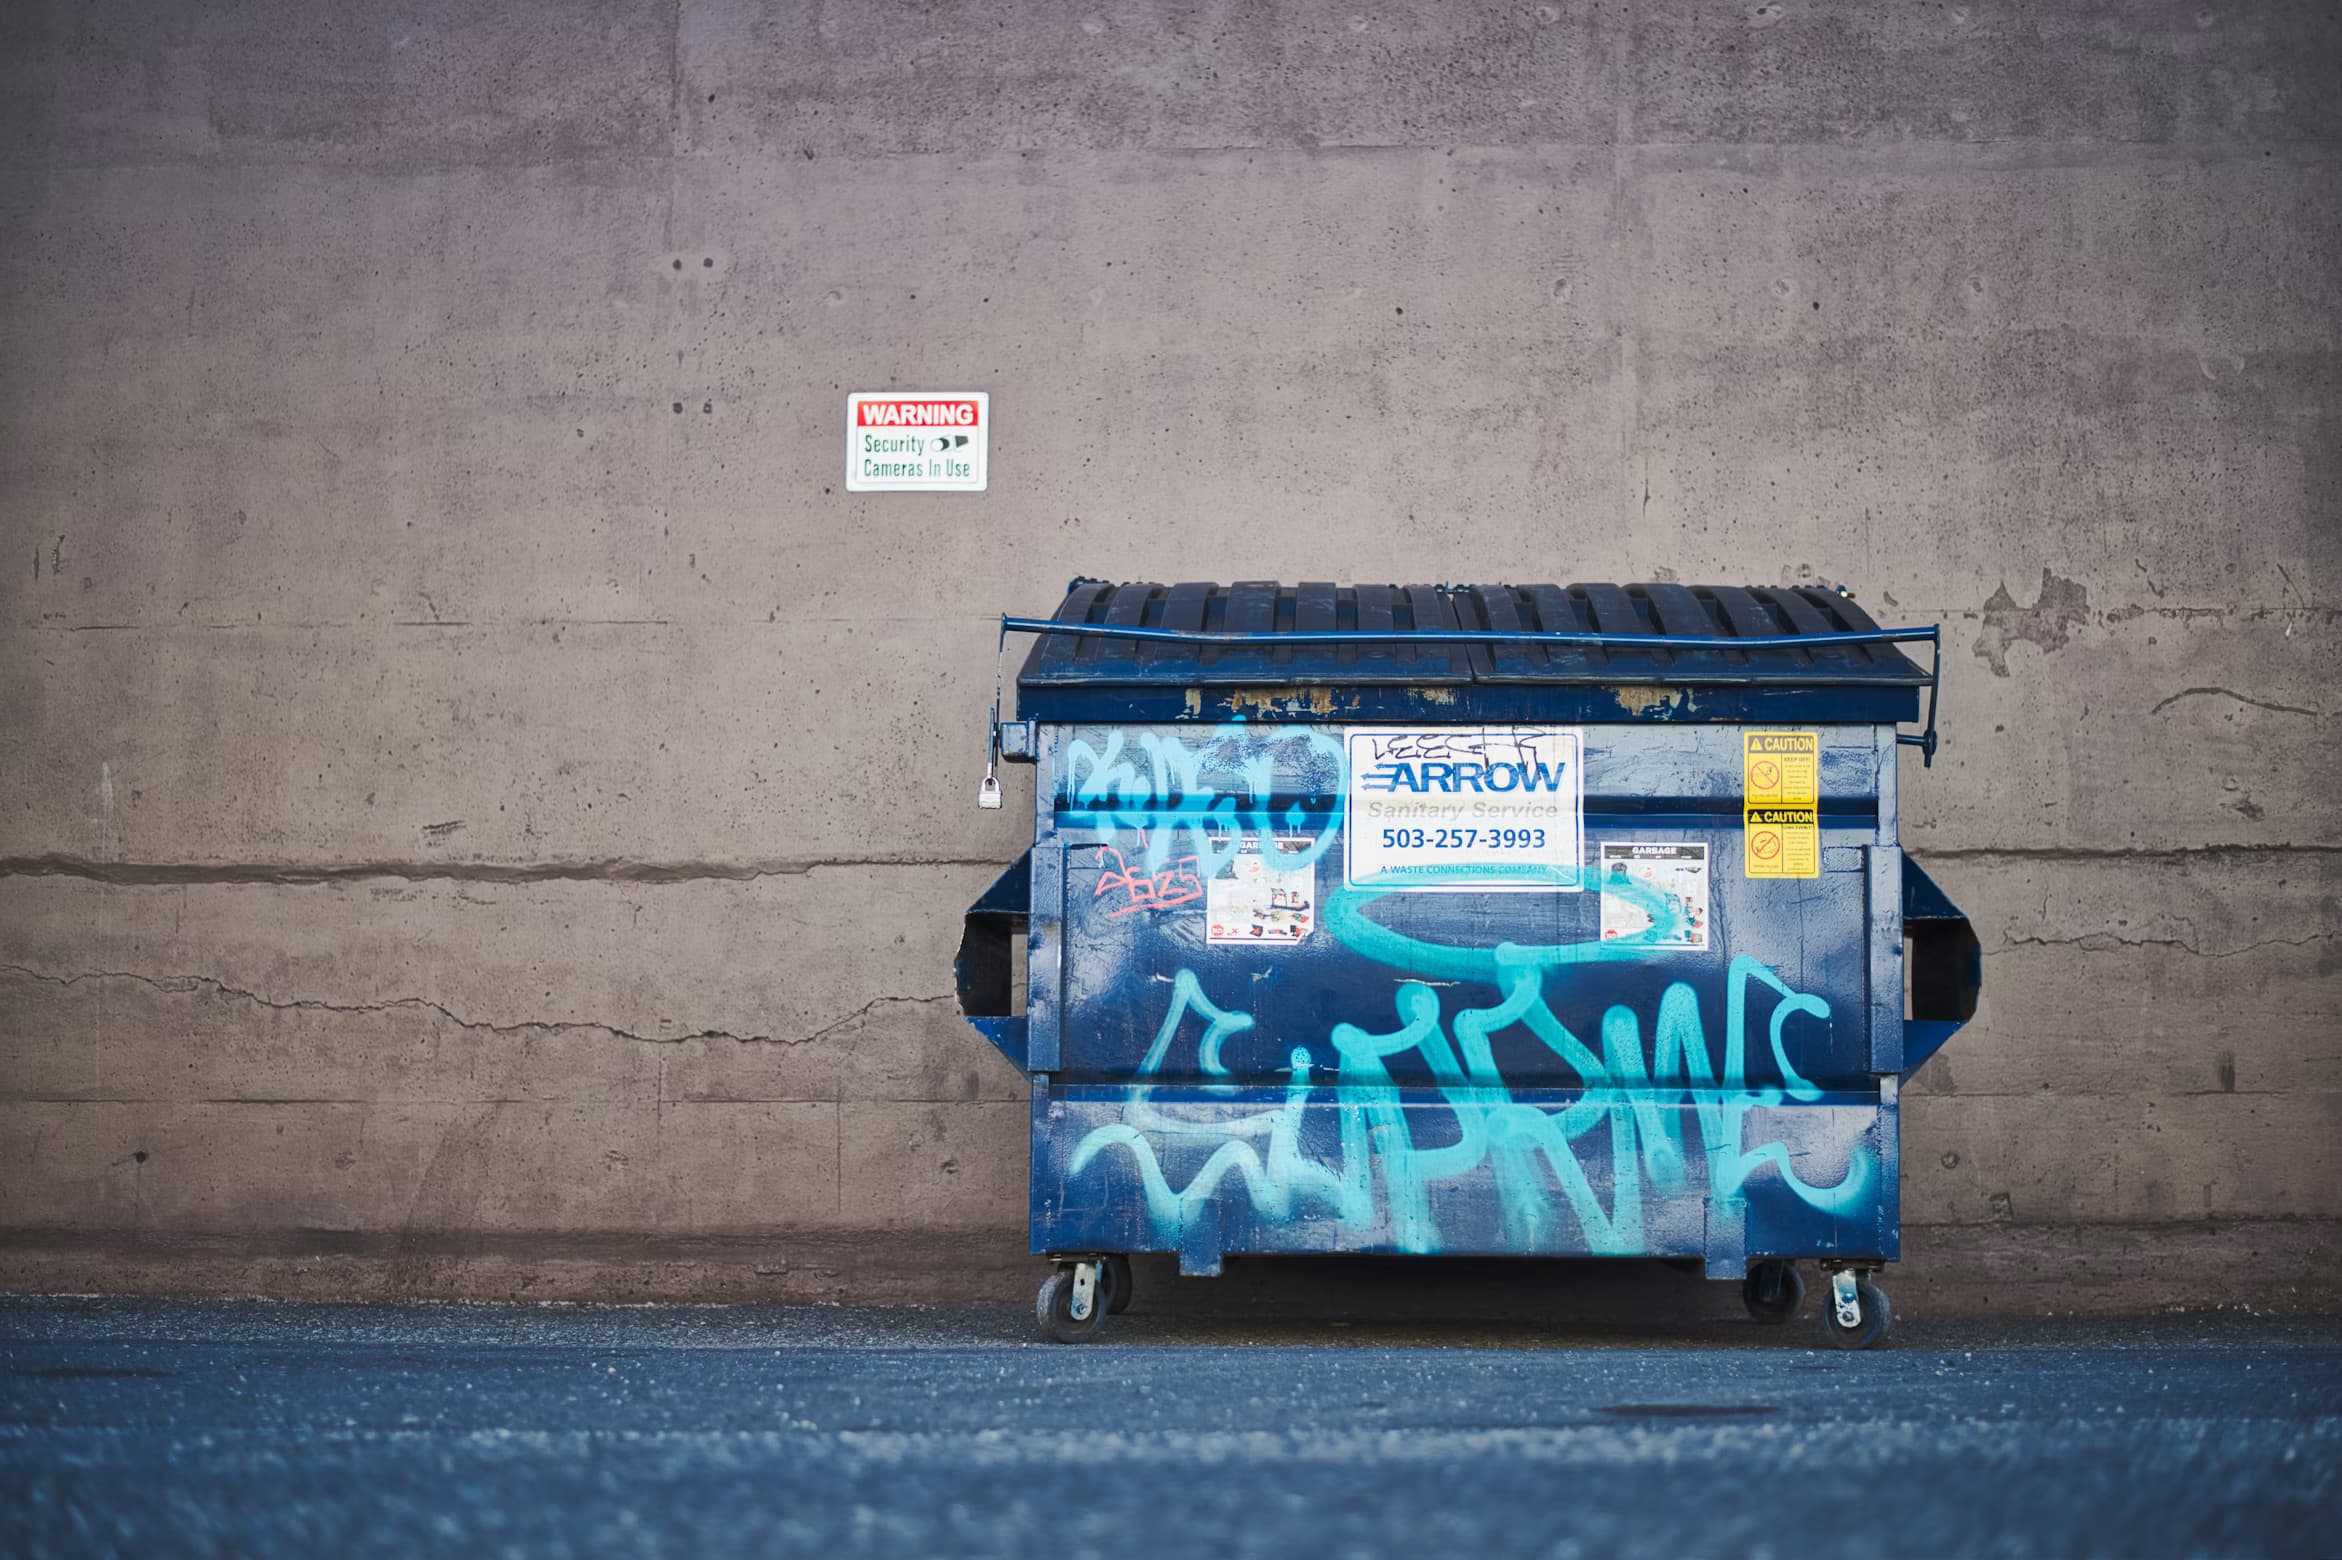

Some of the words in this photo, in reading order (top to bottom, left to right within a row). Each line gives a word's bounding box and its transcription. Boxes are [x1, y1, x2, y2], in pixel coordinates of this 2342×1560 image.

[863, 404, 974, 425] WARNING
[865, 434, 925, 456] Security
[864, 459, 923, 477] Cameras
[929, 459, 941, 477] In
[946, 459, 970, 477] Use
[1764, 737, 1814, 751] CAUTION
[1387, 762, 1566, 793] ARROW
[1368, 801, 1464, 821] Sanitary
[1472, 801, 1558, 818] Service
[1764, 811, 1814, 823] CAUTION
[1382, 829, 1546, 849] 503-257-3993
[1381, 866, 1388, 874] A
[1391, 866, 1424, 874] WASTE
[1426, 865, 1495, 874] CONNECTIONS
